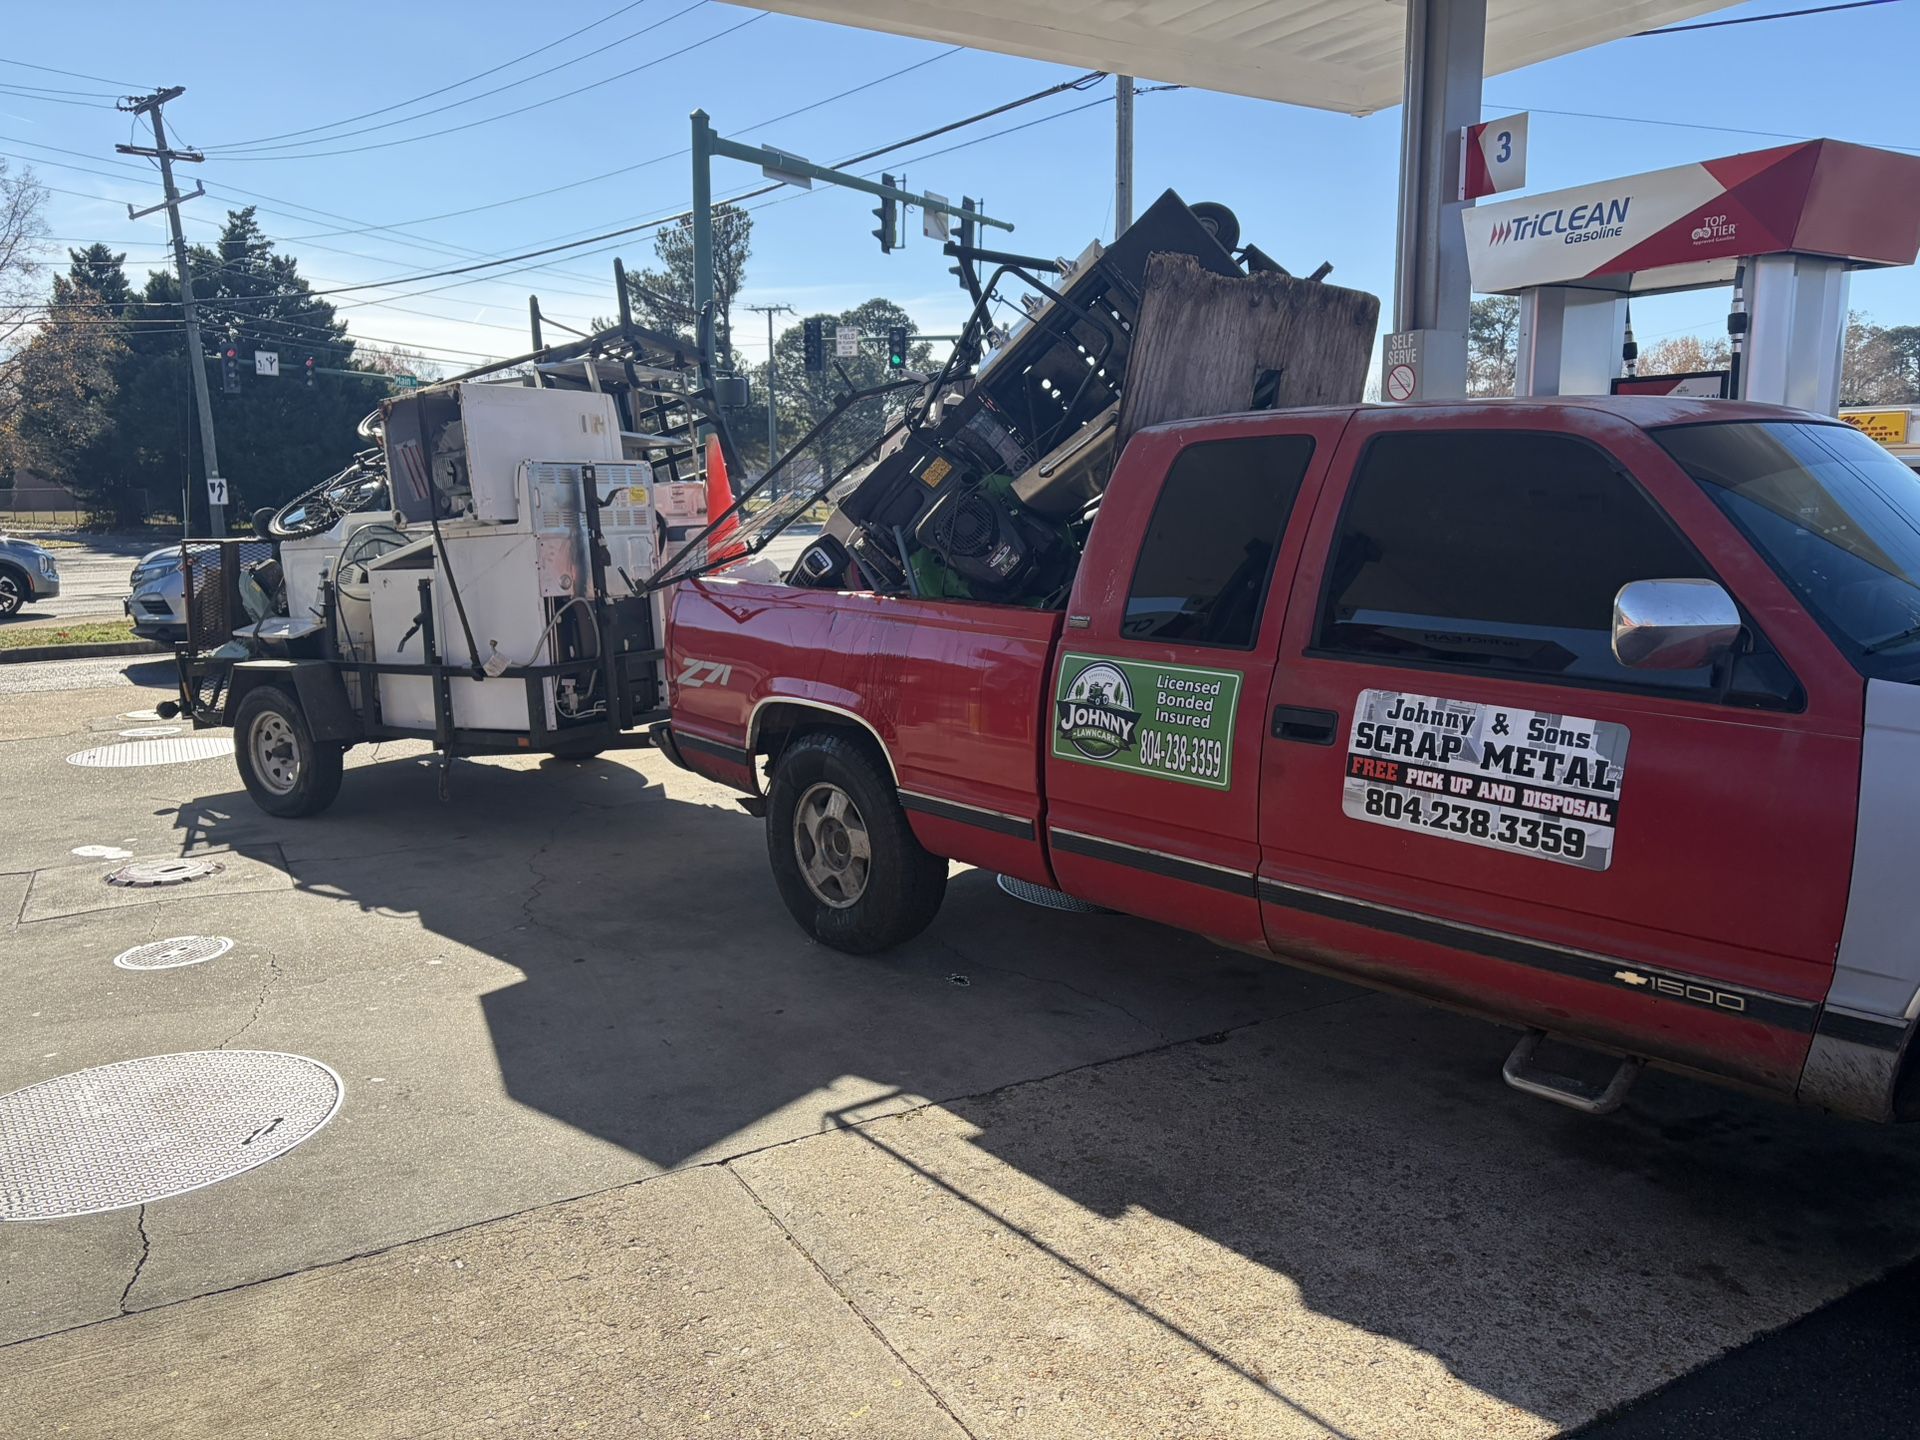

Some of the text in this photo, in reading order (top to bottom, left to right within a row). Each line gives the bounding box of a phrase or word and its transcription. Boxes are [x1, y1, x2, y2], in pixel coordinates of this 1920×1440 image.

[1496, 131, 1512, 163] 3
[1512, 197, 1631, 241] TriCLEAN
[1704, 214, 1727, 228] TOP
[1711, 223, 1736, 237] TIER
[1564, 226, 1623, 245] Gasoline
[1391, 333, 1414, 350] SELF
[1387, 348, 1417, 366] SERVE
[395, 375, 411, 386] Main
[677, 657, 733, 688] Z71
[1156, 674, 1222, 696] Licensed
[1157, 691, 1215, 712] Bonded
[1061, 703, 1135, 742] JOHNNY
[1155, 707, 1212, 729] Insured
[1386, 698, 1592, 749] Johnny & Sons
[1076, 728, 1116, 744] LAWNCARE
[1140, 728, 1222, 778] 804-238-3359
[1355, 721, 1617, 793] SCRAP METAL
[1351, 756, 1612, 822] FREE PICK UP AND DISPOSAL
[1365, 787, 1587, 859] 804.238.3359
[1649, 976, 1745, 1011] 1500
